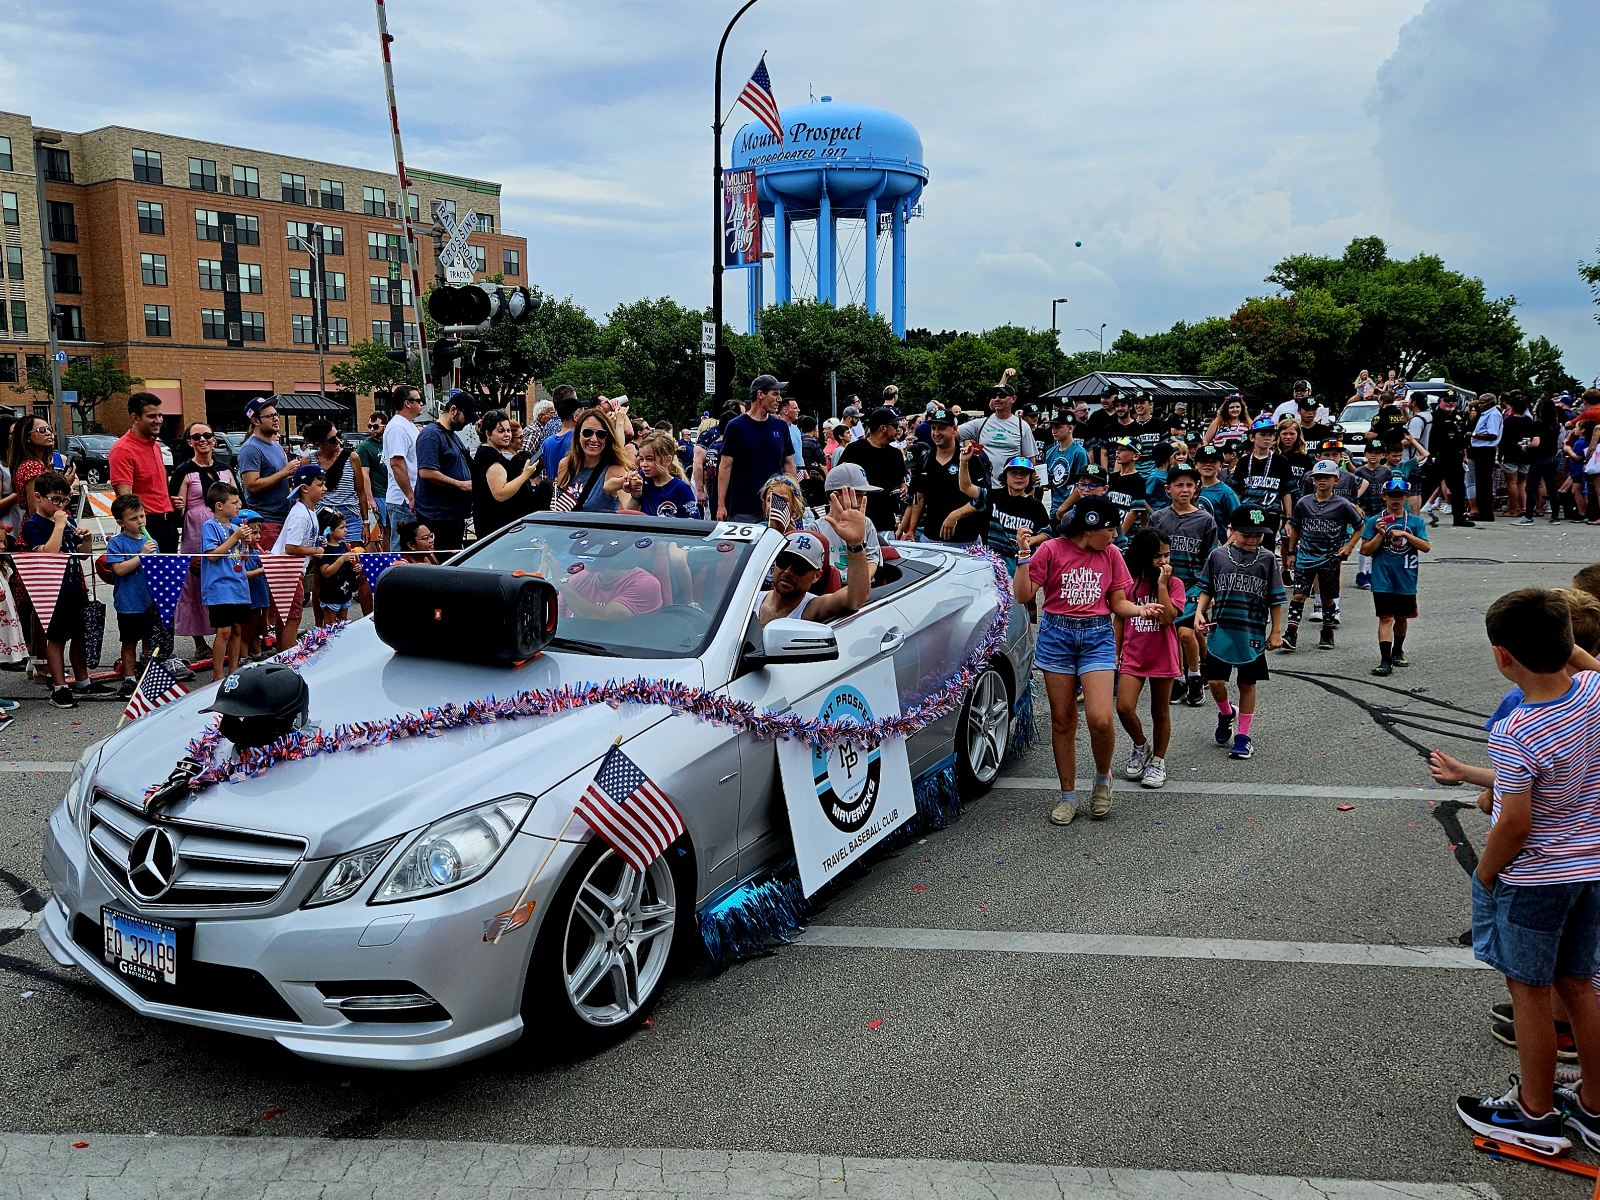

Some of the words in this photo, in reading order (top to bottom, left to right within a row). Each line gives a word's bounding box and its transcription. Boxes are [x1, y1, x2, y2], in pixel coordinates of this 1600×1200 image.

[789, 121, 862, 146] Prospect
[748, 149, 816, 165] INCORPORATED
[821, 148, 848, 157] 1917
[726, 171, 753, 187] MOUNT
[726, 184, 754, 196] PROSPECT
[438, 206, 455, 235] RAIL
[460, 242, 477, 270] ROAD
[441, 213, 477, 266] CROSSING
[455, 253, 461, 265] 3
[449, 270, 471, 279] TRACKS
[1261, 490, 1277, 505] 17
[723, 524, 754, 537] 26
[1404, 554, 1418, 569] 12
[1061, 572, 1103, 584] FAMILY
[1060, 588, 1102, 599] FIGHTS
[835, 693, 871, 721] PROSPE
[832, 780, 876, 824] MAVERICKS
[822, 849, 849, 873] TRAVEL
[849, 823, 882, 854] BASEBALL
[882, 808, 899, 827] CLUB
[106, 926, 122, 959] EQ
[130, 934, 175, 974] 32189
[128, 964, 156, 978] GENEVA
